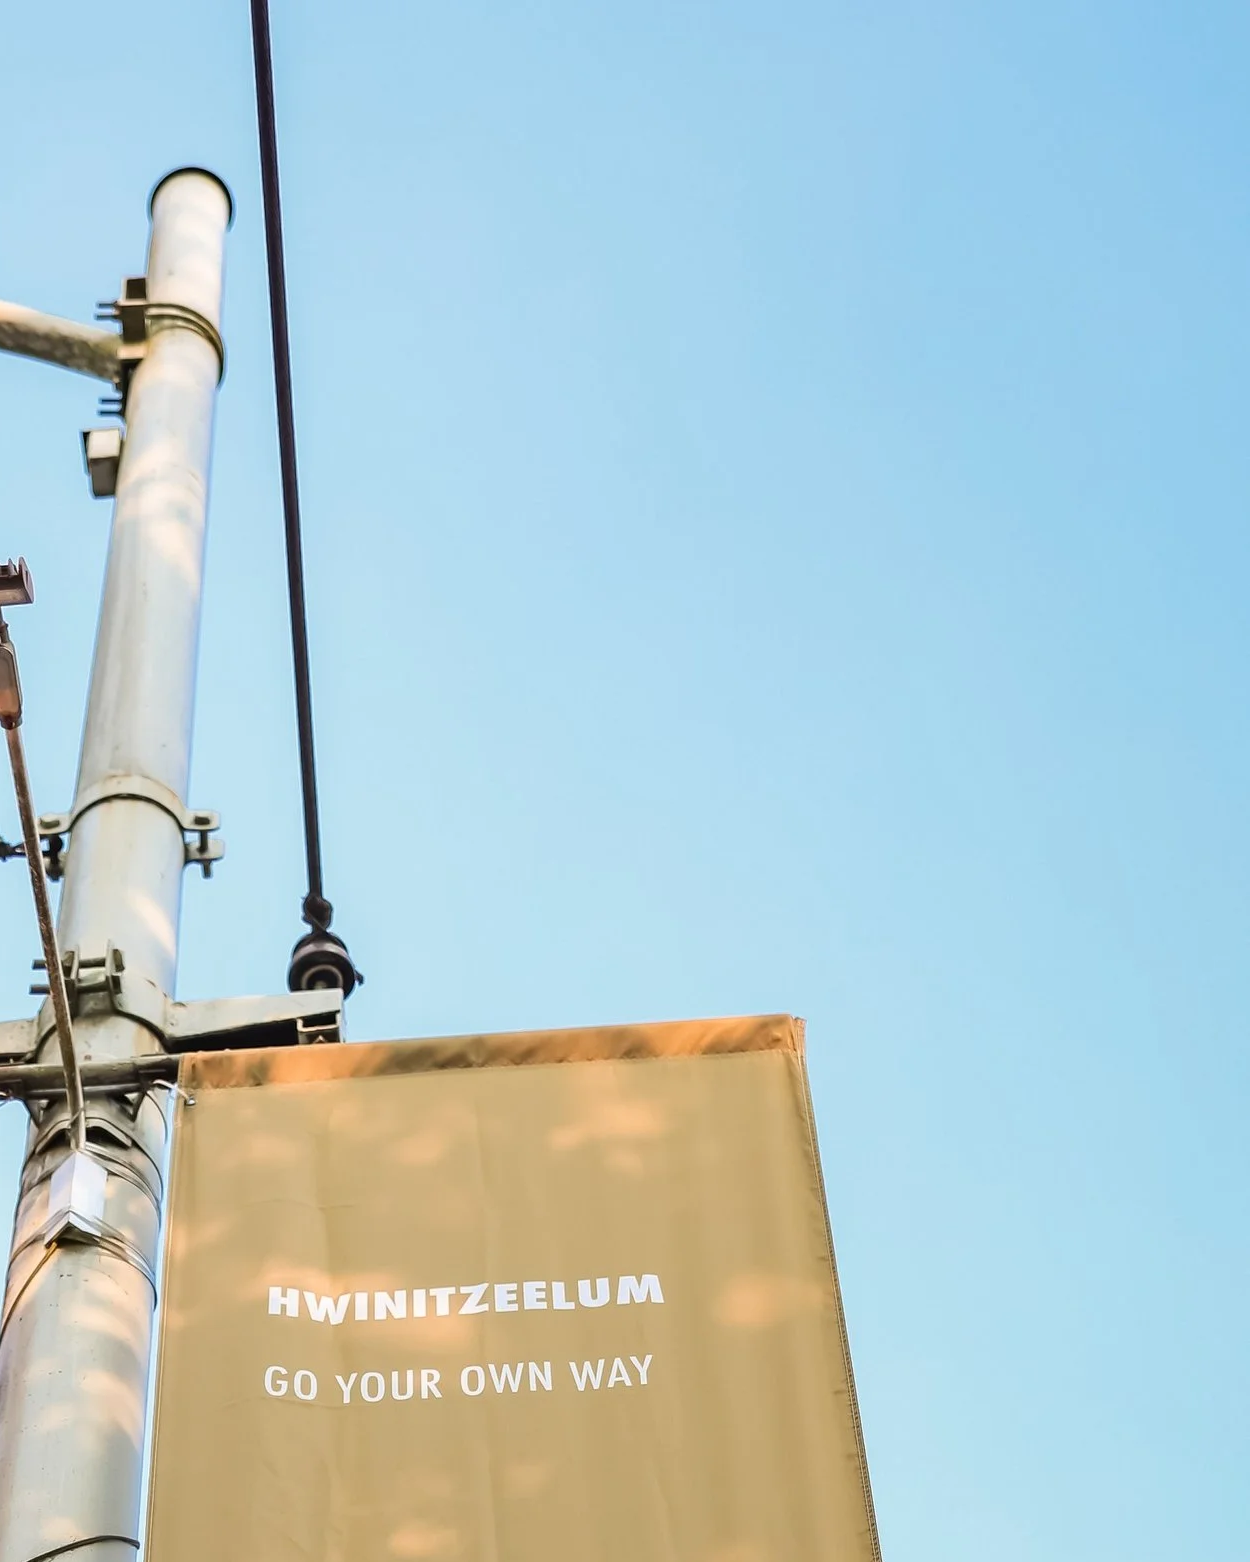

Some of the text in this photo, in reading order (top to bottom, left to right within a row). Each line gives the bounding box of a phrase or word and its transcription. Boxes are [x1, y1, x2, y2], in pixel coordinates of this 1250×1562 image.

[267, 1273, 665, 1326] HWINITZEELUM
[264, 1354, 654, 1404] GO YOUR OWN WAY
